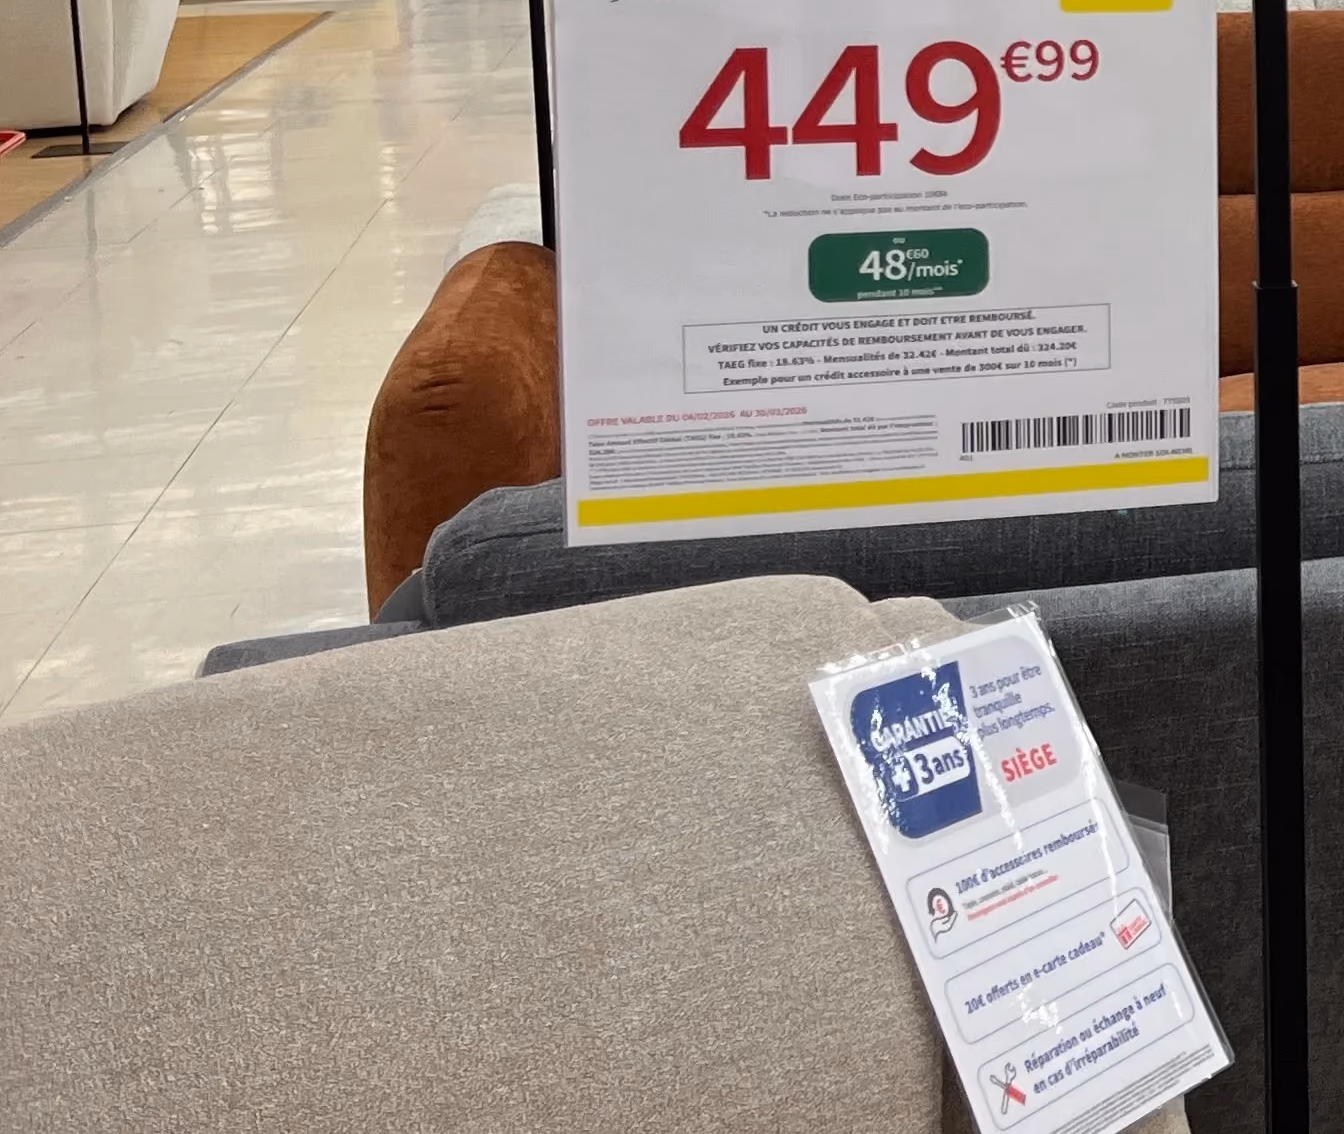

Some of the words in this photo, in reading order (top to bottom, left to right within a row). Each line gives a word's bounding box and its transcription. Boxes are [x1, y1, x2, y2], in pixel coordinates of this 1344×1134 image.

[708, 342, 756, 353] VÉRIFIEZ
[758, 341, 780, 351] VOS
[782, 338, 840, 350] CAPACITÉS
[842, 337, 856, 347] DE
[858, 332, 953, 345] REMBOURSEMENT
[955, 330, 988, 340] AVANT
[990, 329, 1004, 339] DE
[1006, 327, 1035, 337] VOUS
[762, 325, 779, 334] UN
[781, 322, 819, 333] CRÉDIT
[822, 321, 851, 331] VOUS
[853, 319, 895, 329] ENGAGE
[897, 317, 910, 327] ET
[913, 316, 938, 326] DOIT
[718, 360, 745, 370] TAEG
[747, 358, 767, 368] fixe
[823, 351, 885, 364] Mensualités
[888, 351, 900, 360] de
[723, 375, 769, 387] Exemple
[770, 374, 796, 386] pour
[814, 370, 845, 381] crédit
[847, 366, 901, 380] accessoire
[963, 362, 977, 373] de
[969, 685, 978, 699] 3
[980, 680, 996, 695] ans
[997, 672, 1020, 693] pour
[1020, 665, 1042, 681] être
[973, 692, 1022, 719] tranquille
[1001, 742, 1057, 783] SIÈGE
[986, 977, 1020, 1002] offerts
[1020, 971, 1033, 986] en
[1033, 954, 1068, 979] e-carte
[1024, 1032, 1079, 1073] Réparation
[1079, 1024, 1093, 1043] ou
[1093, 1004, 1136, 1035] échange
[1135, 995, 1143, 1012] à
[1144, 982, 1168, 1007] neuf
[1033, 1080, 1047, 1095] en
[1048, 1070, 1065, 1089] cas
[1065, 1021, 1141, 1078] d'irréparabilité
